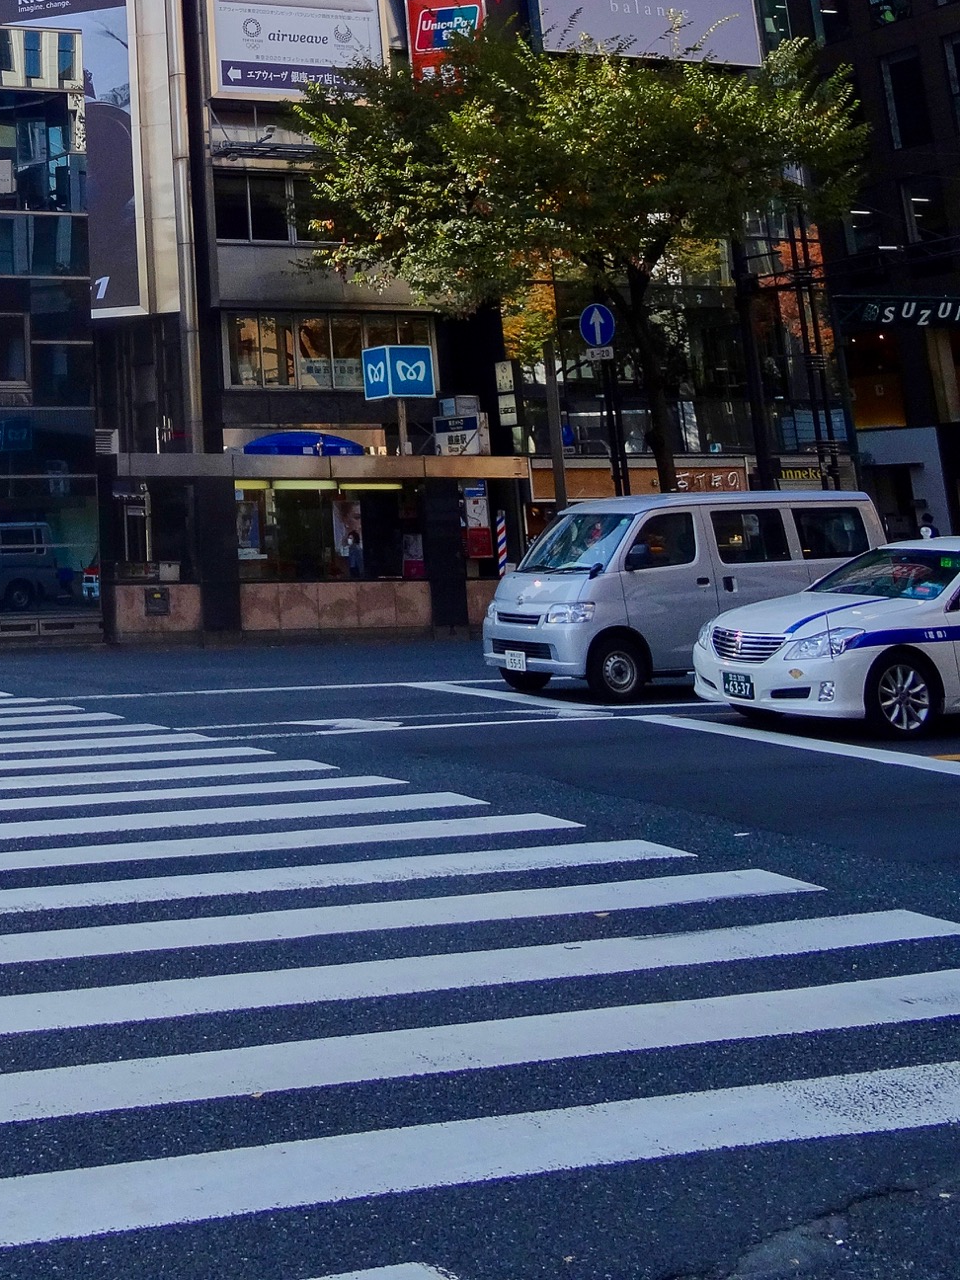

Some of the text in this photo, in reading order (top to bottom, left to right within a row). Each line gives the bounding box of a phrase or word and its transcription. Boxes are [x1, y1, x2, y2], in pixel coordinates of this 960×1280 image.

[18, 0, 72, 13] imagine. change.
[268, 29, 329, 45] airweave
[729, 680, 751, 695] 63-37
